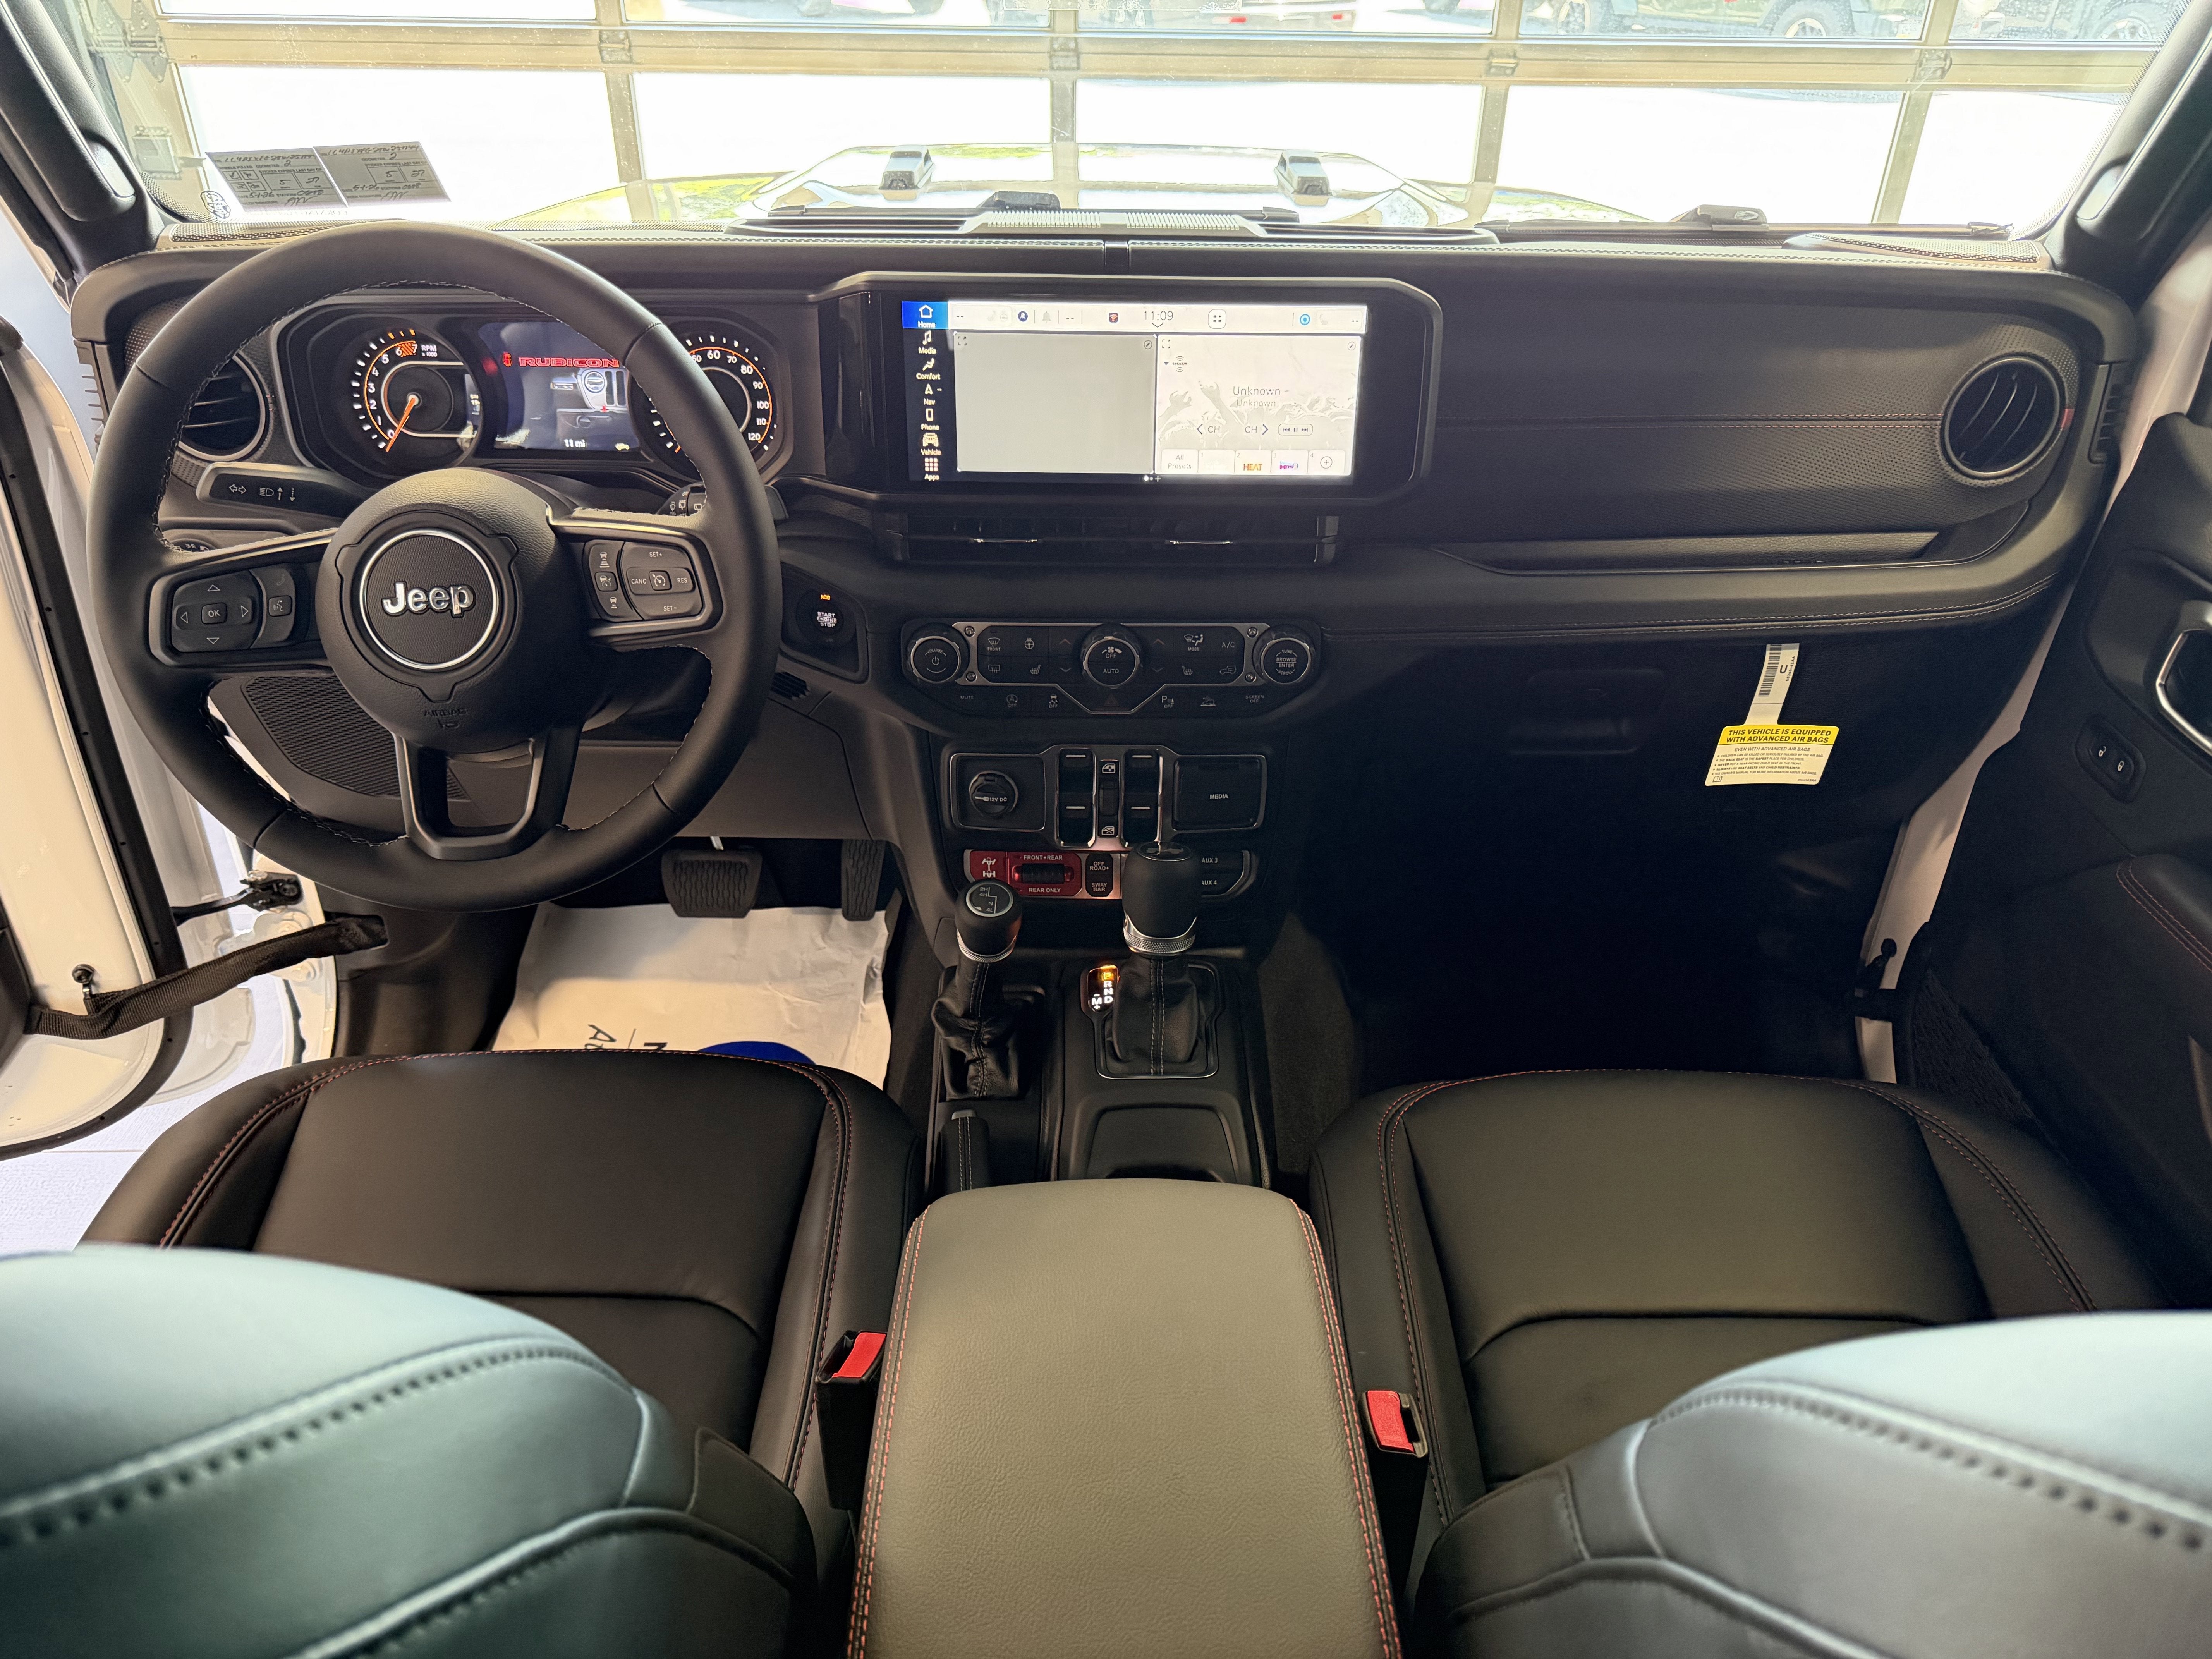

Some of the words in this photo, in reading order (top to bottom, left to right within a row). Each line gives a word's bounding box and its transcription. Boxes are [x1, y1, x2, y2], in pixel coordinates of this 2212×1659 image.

[1144, 311, 1173, 321] 11:09
[395, 347, 403, 356] 6
[413, 344, 418, 353] 7
[382, 354, 389, 364] 5
[707, 350, 721, 359] 60
[519, 357, 620, 368] RUBICON
[726, 355, 737, 364] 70
[372, 367, 379, 377] 4
[740, 364, 753, 374] 80
[368, 383, 375, 393] 3
[752, 381, 763, 390] 90
[1233, 386, 1281, 395] Unknown
[370, 400, 377, 410] 2
[757, 400, 769, 409] 100
[377, 416, 381, 426] 1
[756, 417, 766, 426] 110
[387, 429, 395, 439] 0
[748, 433, 761, 441] 120
[575, 439, 586, 448] mi
[382, 581, 475, 617] Jeep
[1779, 665, 1788, 673] U
[1103, 972, 1111, 980] P
[1104, 988, 1114, 996] N
[1091, 997, 1102, 1005] M
